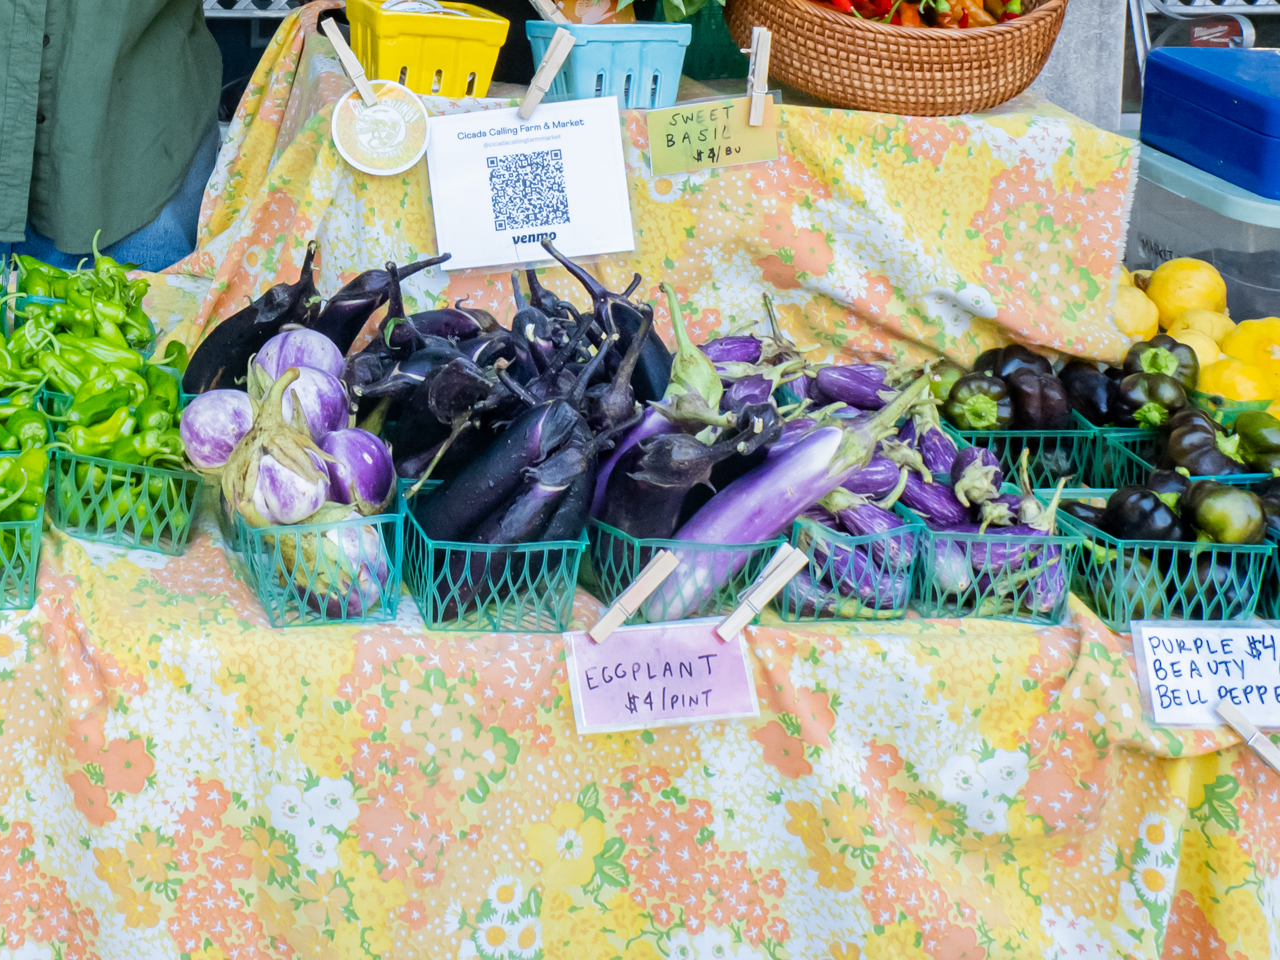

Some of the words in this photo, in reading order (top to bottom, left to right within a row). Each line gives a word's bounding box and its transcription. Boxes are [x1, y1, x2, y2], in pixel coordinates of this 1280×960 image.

[669, 105, 735, 127] SWEET
[457, 129, 487, 140] Cicada
[489, 126, 518, 136] Calling
[520, 122, 542, 133] Farm
[543, 121, 550, 130] &
[552, 118, 585, 129] Market
[665, 124, 731, 148] BASIL
[483, 134, 561, 149] @cicadacallingfarmmarket
[512, 231, 557, 245] venmo
[1148, 635, 1234, 656] PURPLE
[1245, 634, 1277, 662] $4
[584, 653, 718, 690] EGGPLANT
[1153, 658, 1245, 680] BEAUTY
[625, 687, 713, 714] $4/PINT
[1155, 684, 1209, 709] BELL
